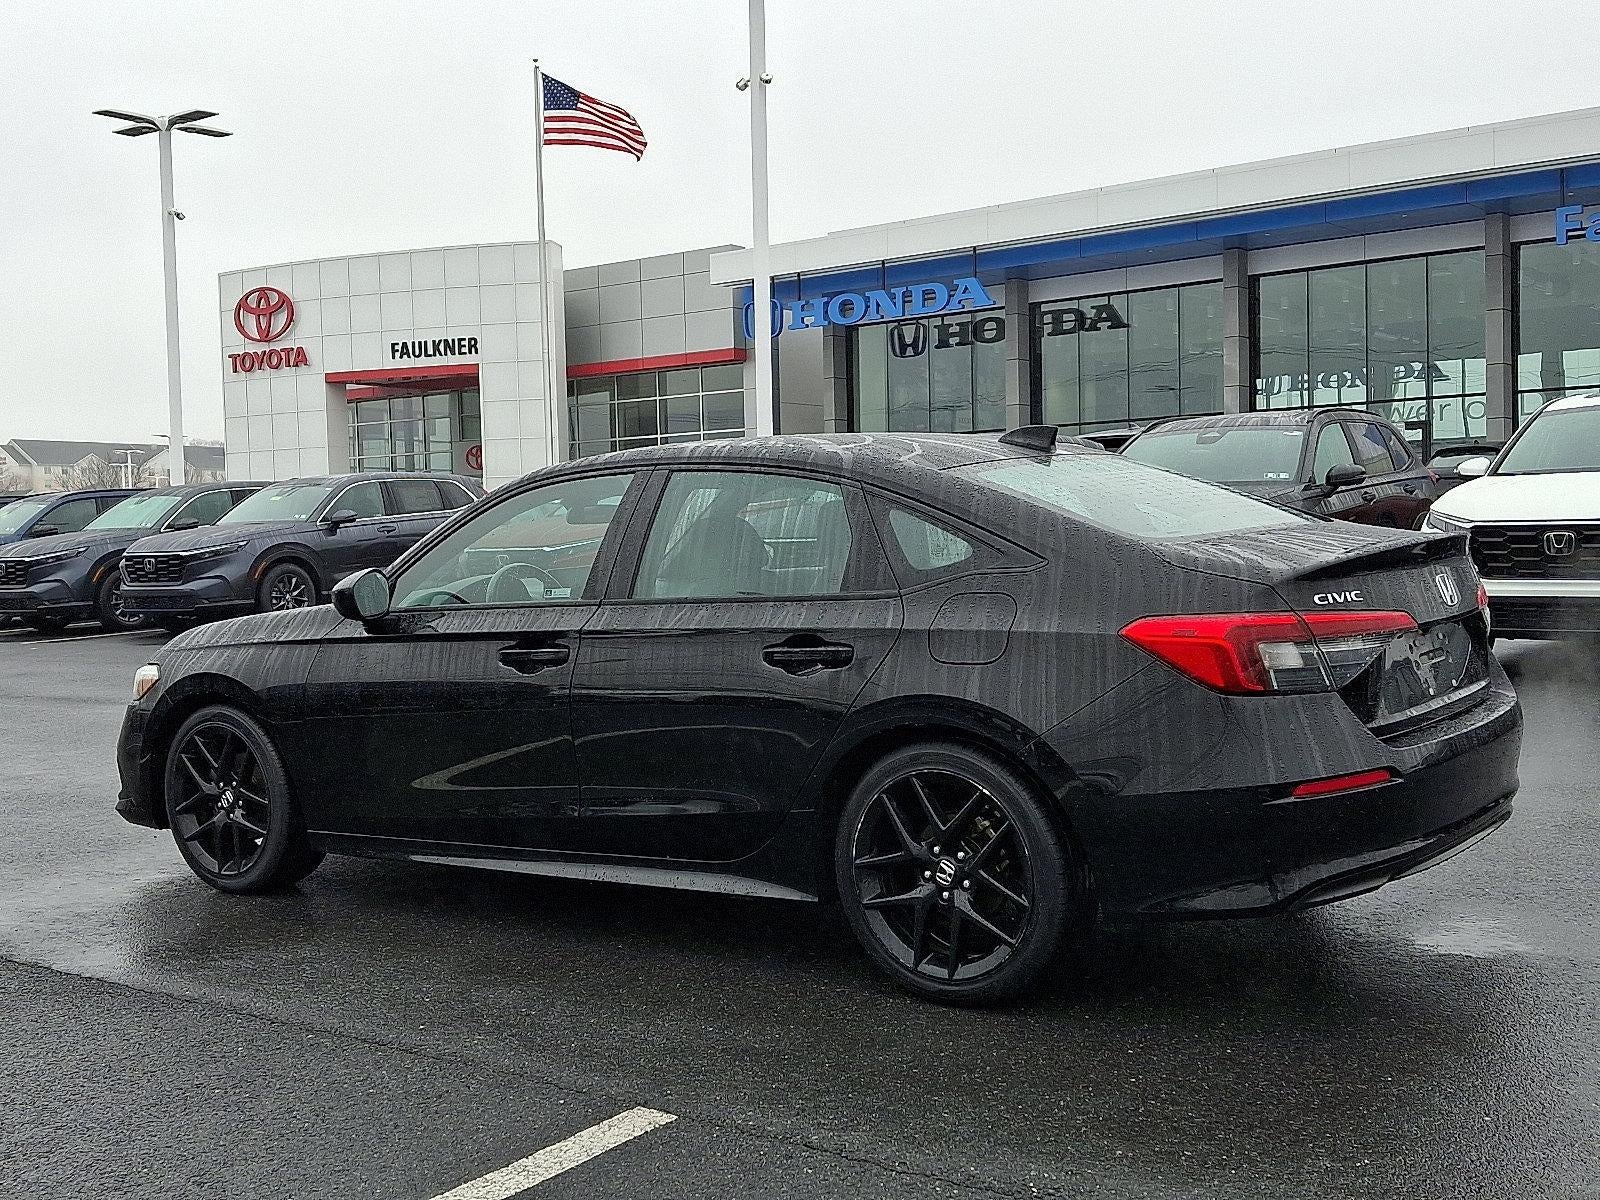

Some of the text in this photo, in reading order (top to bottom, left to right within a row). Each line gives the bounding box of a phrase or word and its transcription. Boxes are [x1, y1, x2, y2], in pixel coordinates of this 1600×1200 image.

[788, 277, 996, 331] HONDA
[934, 303, 1130, 349] HODA
[228, 346, 309, 373] TOYOTA
[391, 337, 479, 359] FAULKNER
[1313, 590, 1364, 605] CIVIC
